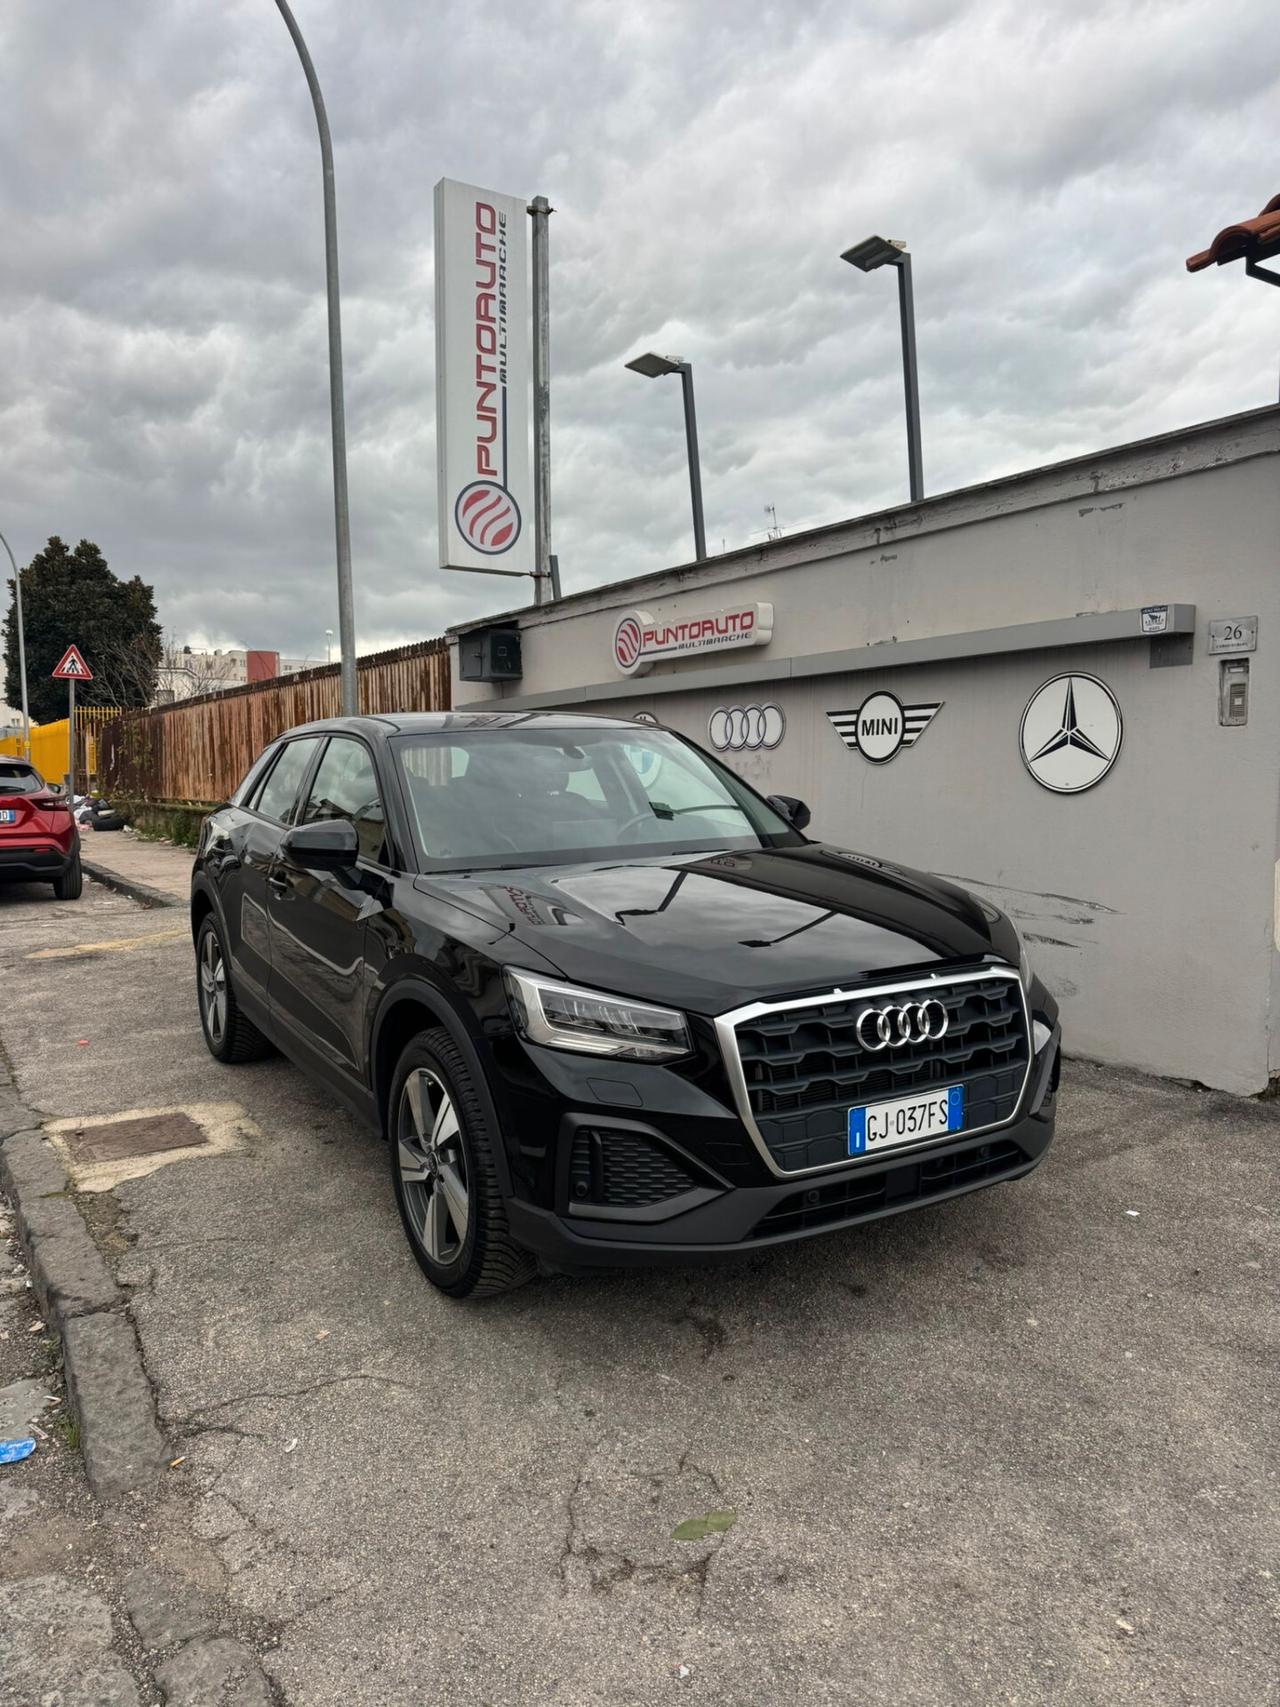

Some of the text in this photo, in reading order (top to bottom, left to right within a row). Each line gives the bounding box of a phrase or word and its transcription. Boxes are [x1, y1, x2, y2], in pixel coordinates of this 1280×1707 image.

[499, 211, 508, 384] MULTIMARCHE
[475, 201, 497, 477] PUNTOAUTO
[643, 610, 754, 648] PUNTOAUTO
[677, 631, 752, 650] MULTIMARCHE
[1223, 624, 1243, 641] 26
[861, 717, 898, 737] MINI
